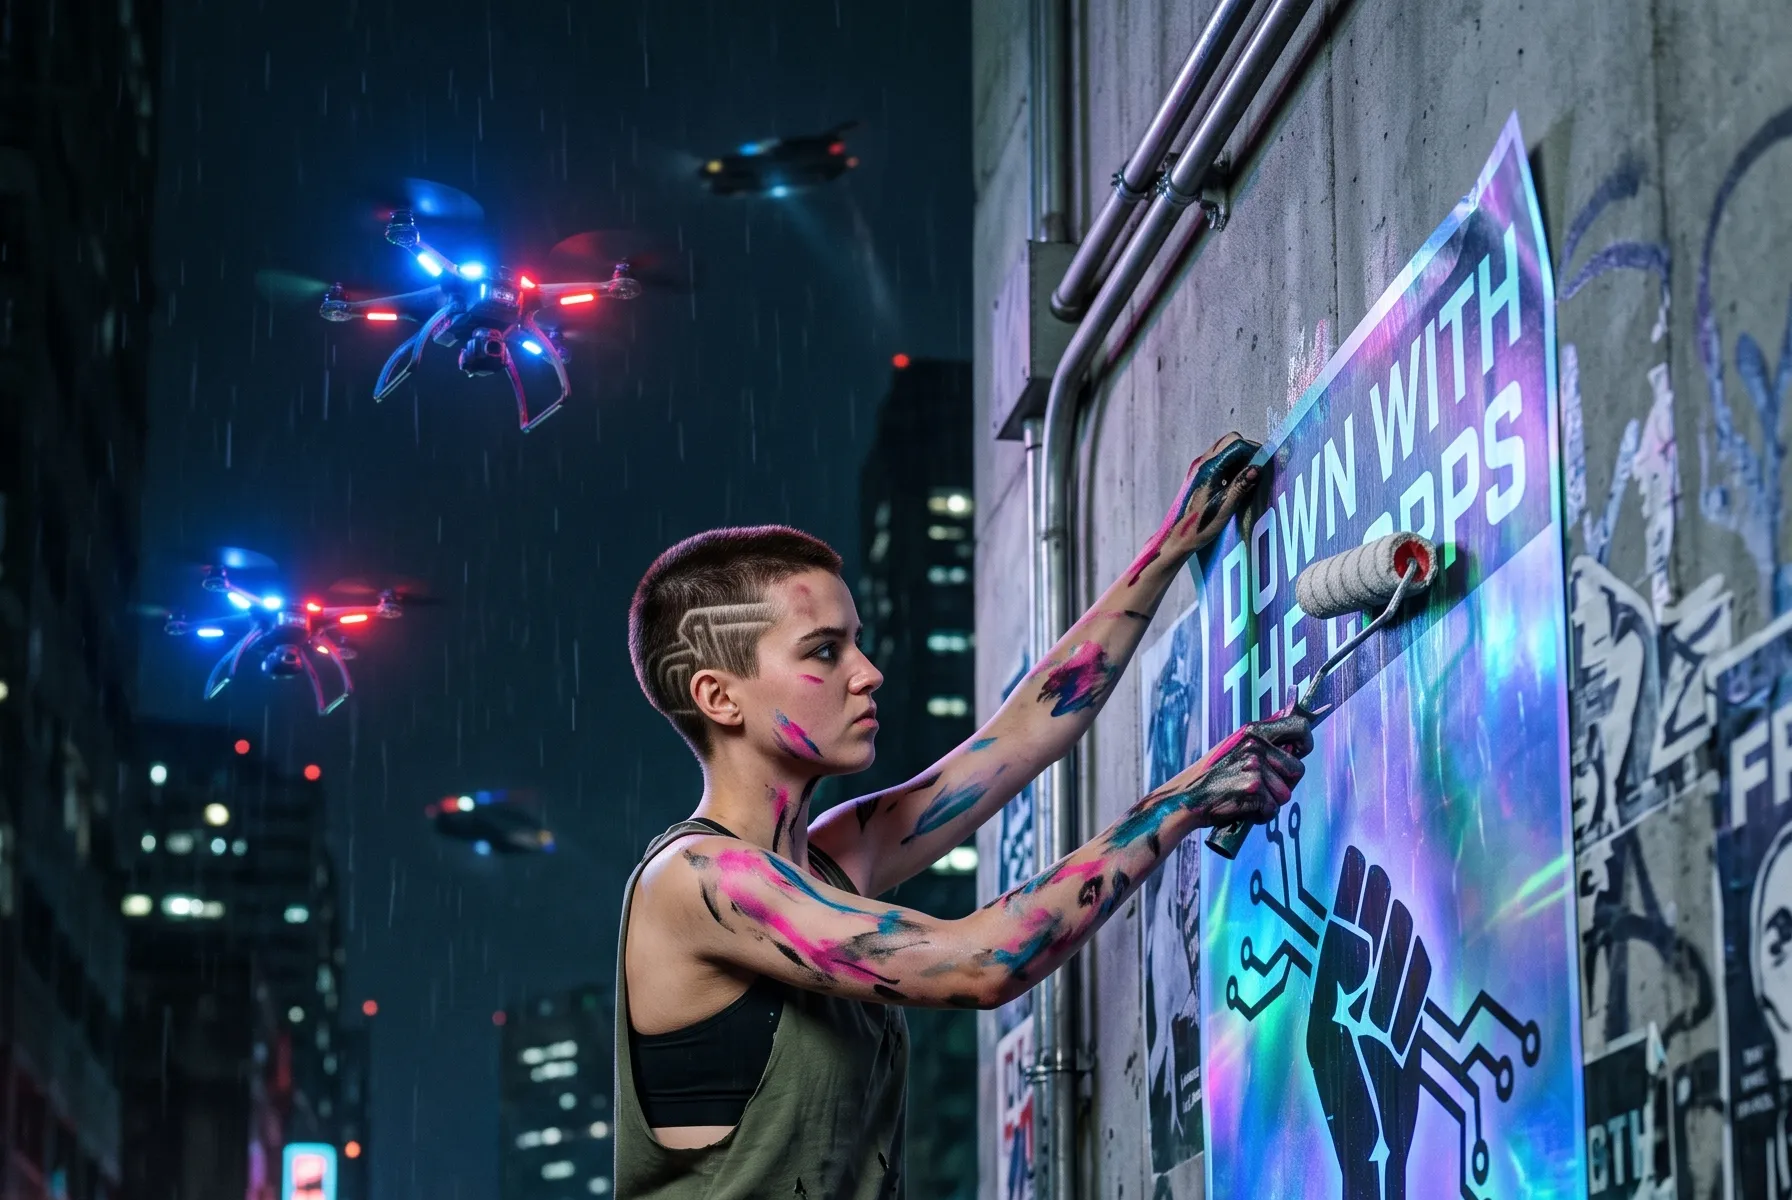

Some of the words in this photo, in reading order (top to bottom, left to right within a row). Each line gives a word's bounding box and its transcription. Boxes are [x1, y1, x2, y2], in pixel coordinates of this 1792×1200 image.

[1222, 413, 1357, 649] DOWN
[1369, 222, 1522, 483] WITH
[1223, 602, 1311, 733] THE
